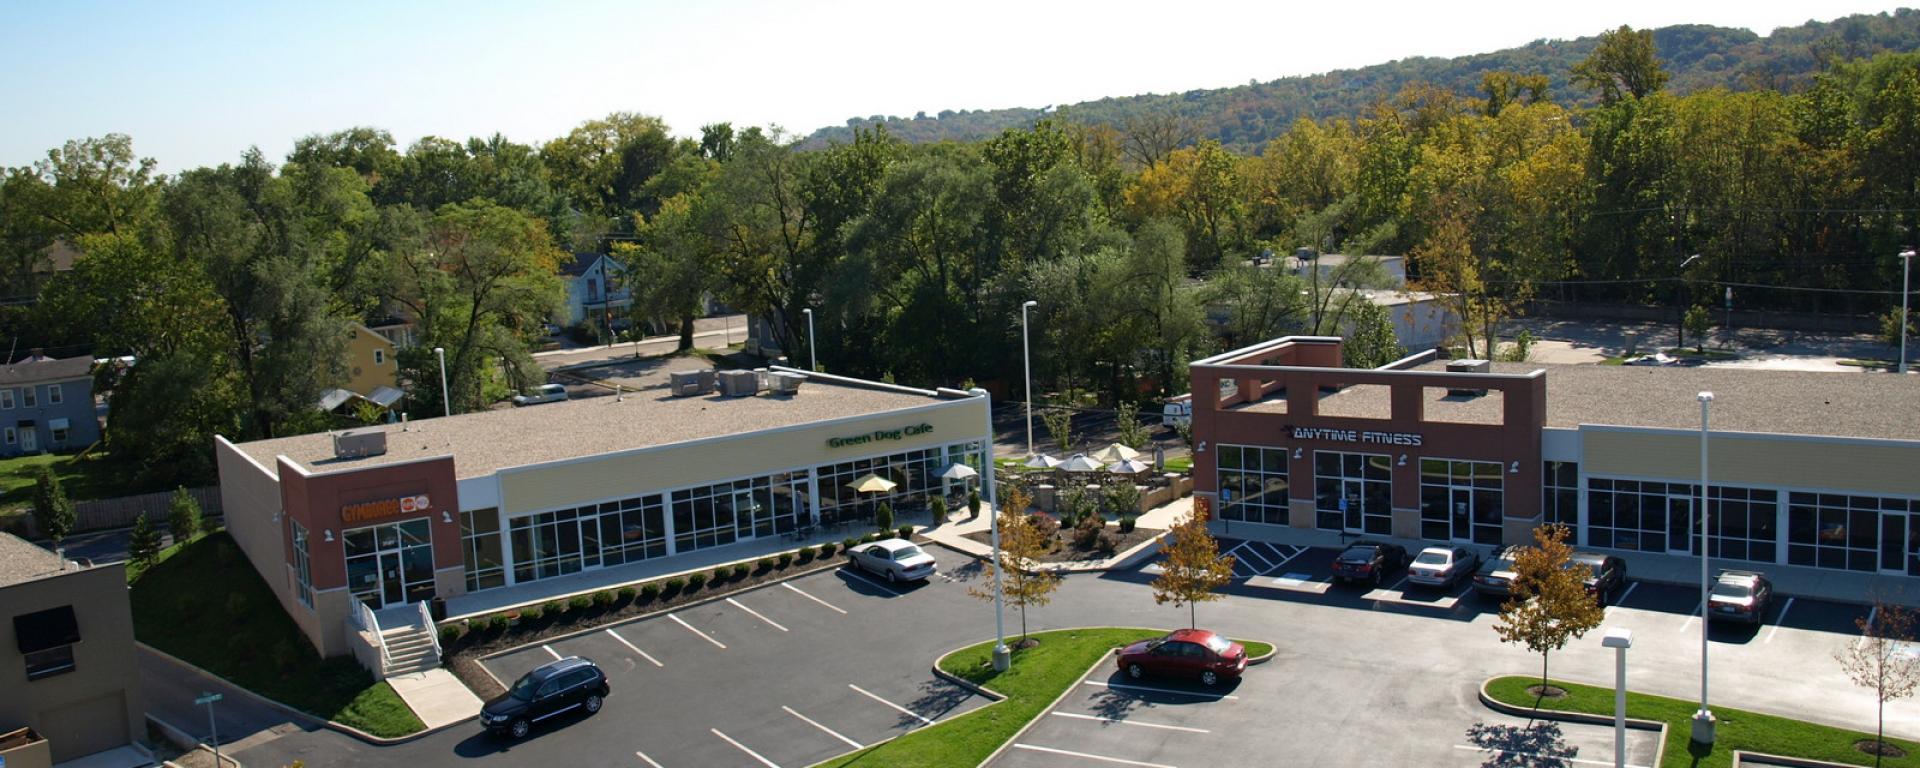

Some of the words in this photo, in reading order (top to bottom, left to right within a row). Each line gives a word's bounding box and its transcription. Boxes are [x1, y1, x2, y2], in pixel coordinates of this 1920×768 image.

[828, 434, 871, 448] Green
[874, 430, 902, 441] Dog
[904, 423, 933, 436] Cafe
[1294, 427, 1357, 442] ANYTIME
[1362, 431, 1422, 446] FITNESS
